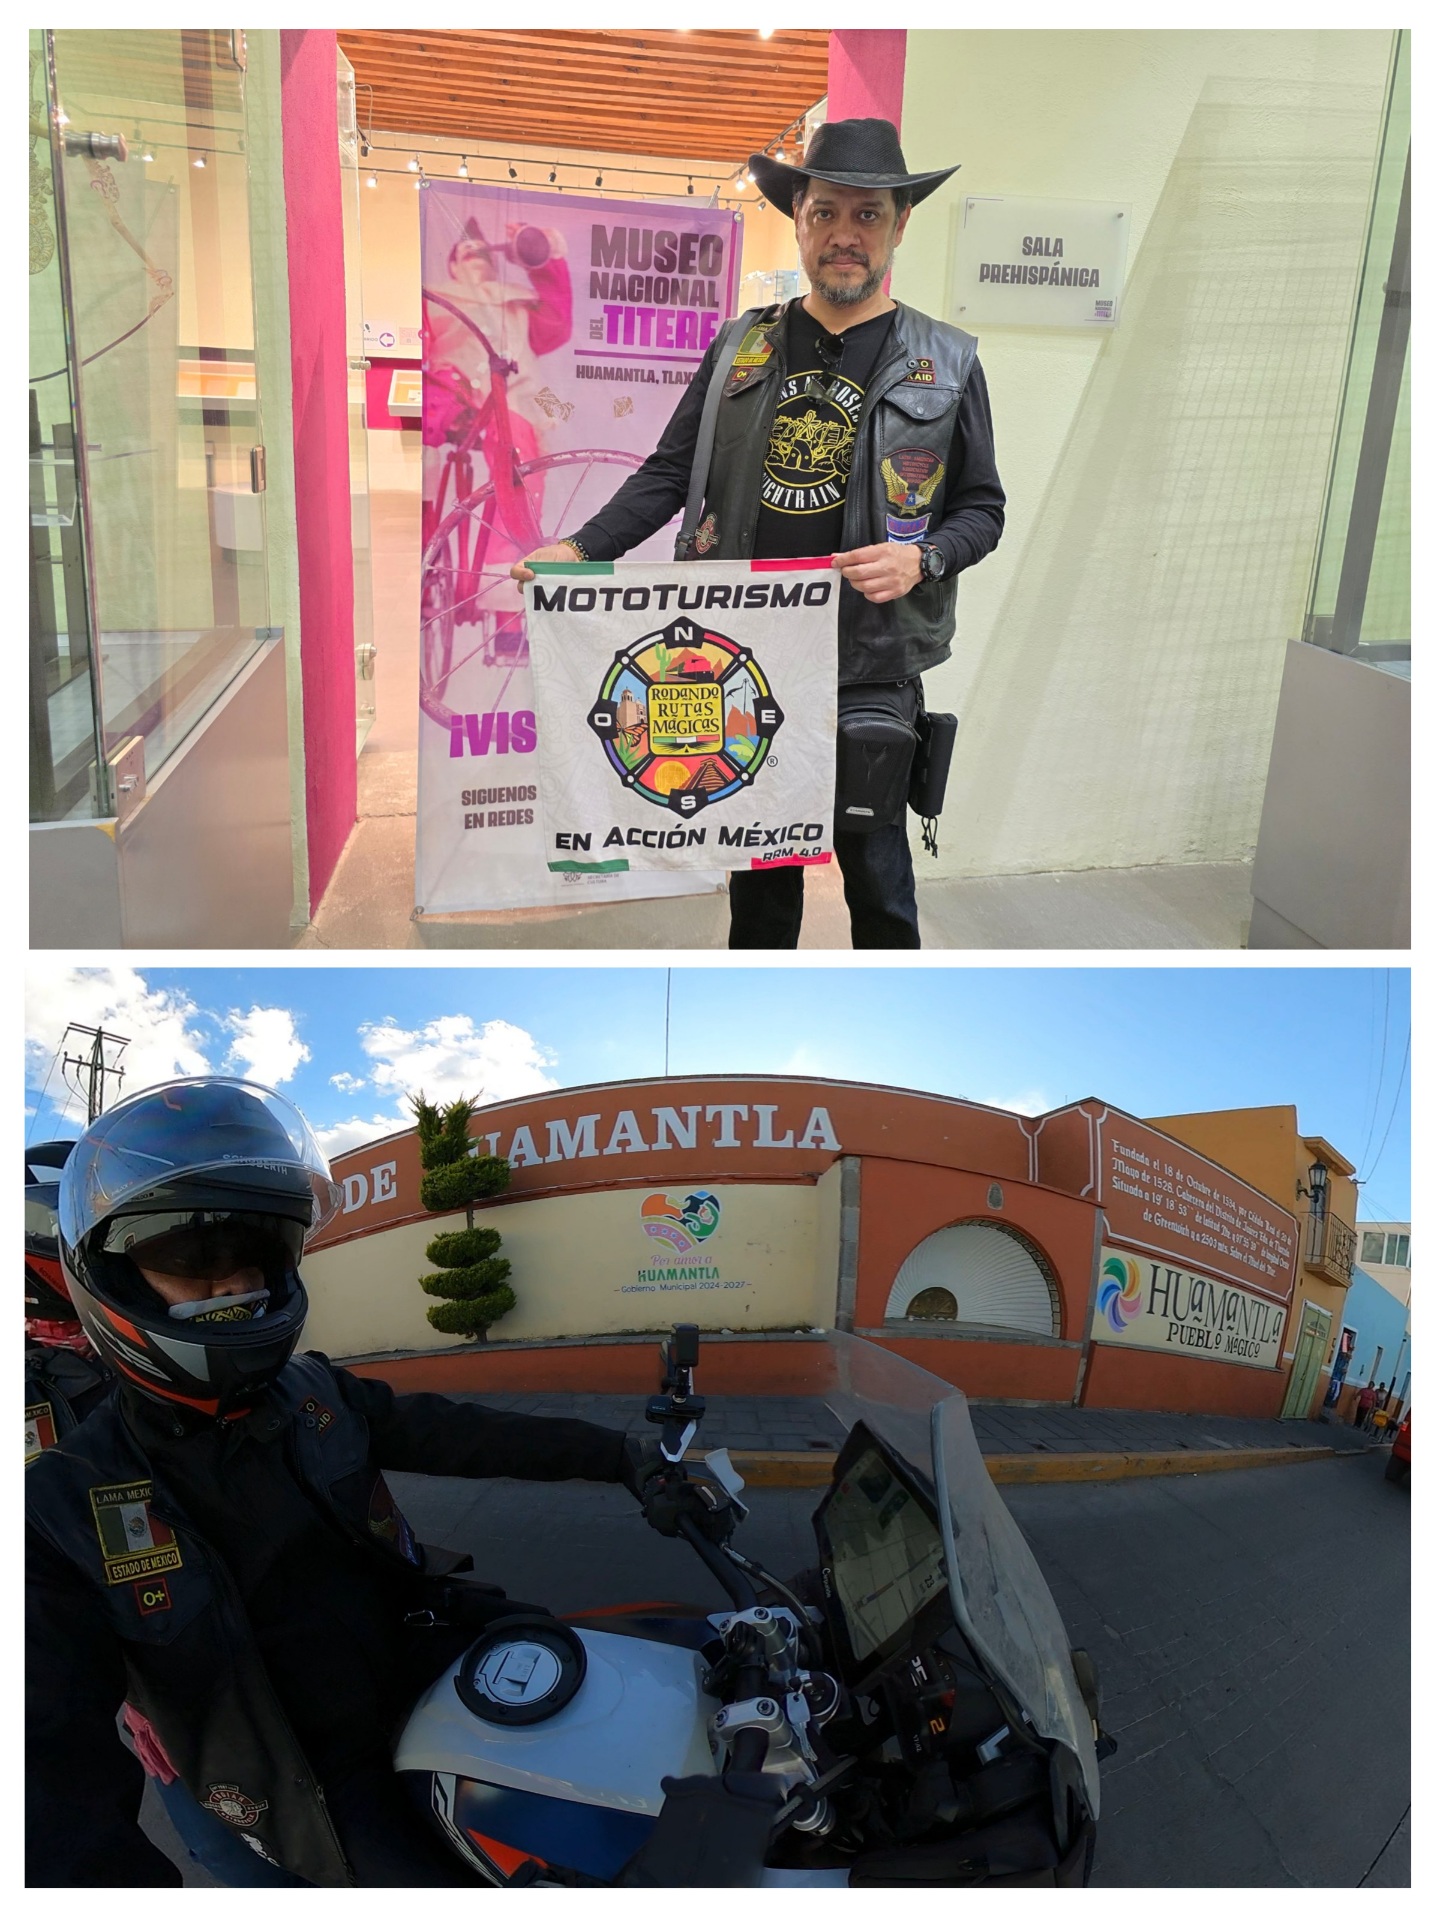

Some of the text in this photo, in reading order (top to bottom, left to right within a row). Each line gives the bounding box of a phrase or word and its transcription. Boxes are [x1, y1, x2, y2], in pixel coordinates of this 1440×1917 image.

[590, 224, 723, 277] MUSEO
[1022, 236, 1064, 257] SALA
[979, 261, 1100, 288] PREHISPÁNICA
[589, 271, 720, 308] NACIONAL
[589, 317, 604, 340] DEL
[603, 304, 719, 351] TITERE
[575, 365, 697, 386] HUAMANTLA, TLAX
[674, 626, 693, 640] N
[594, 712, 612, 727] O
[760, 709, 777, 724] E
[461, 785, 537, 806] SIGUENOS
[680, 795, 697, 810] S
[464, 808, 534, 830] EN REDES
[555, 822, 824, 851] EN ACCIÓN MÉXICO
[799, 846, 822, 857] 4.0
[342, 1104, 842, 1214] DE UAMANTLA
[1112, 1158, 1140, 1179] Mayo
[1141, 1168, 1150, 1183] de
[1176, 1186, 1204, 1209] Cabecera
[1205, 1199, 1214, 1214] del
[1216, 1206, 1234, 1224] Distrito
[1164, 1162, 1173, 1177] 18
[1175, 1167, 1183, 1182] de
[1187, 1174, 1210, 1196] Octubre
[1213, 1188, 1219, 1201] de
[1143, 1206, 1152, 1223] de
[1154, 1212, 1190, 1236] Greenwich
[674, 1255, 701, 1265] amor
[638, 1267, 720, 1282] HUAMANTLA
[660, 1283, 696, 1291] Municipal
[700, 1281, 745, 1289] 2024-2027
[97, 1488, 152, 1503] LAMA MEXIC
[112, 1553, 178, 1578] ESTADO DE MEXICO
[923, 1575, 934, 1588] 23
[143, 1590, 165, 1606] O+
[930, 1718, 946, 1735] 2
[213, 1792, 244, 1802] INDIAN
